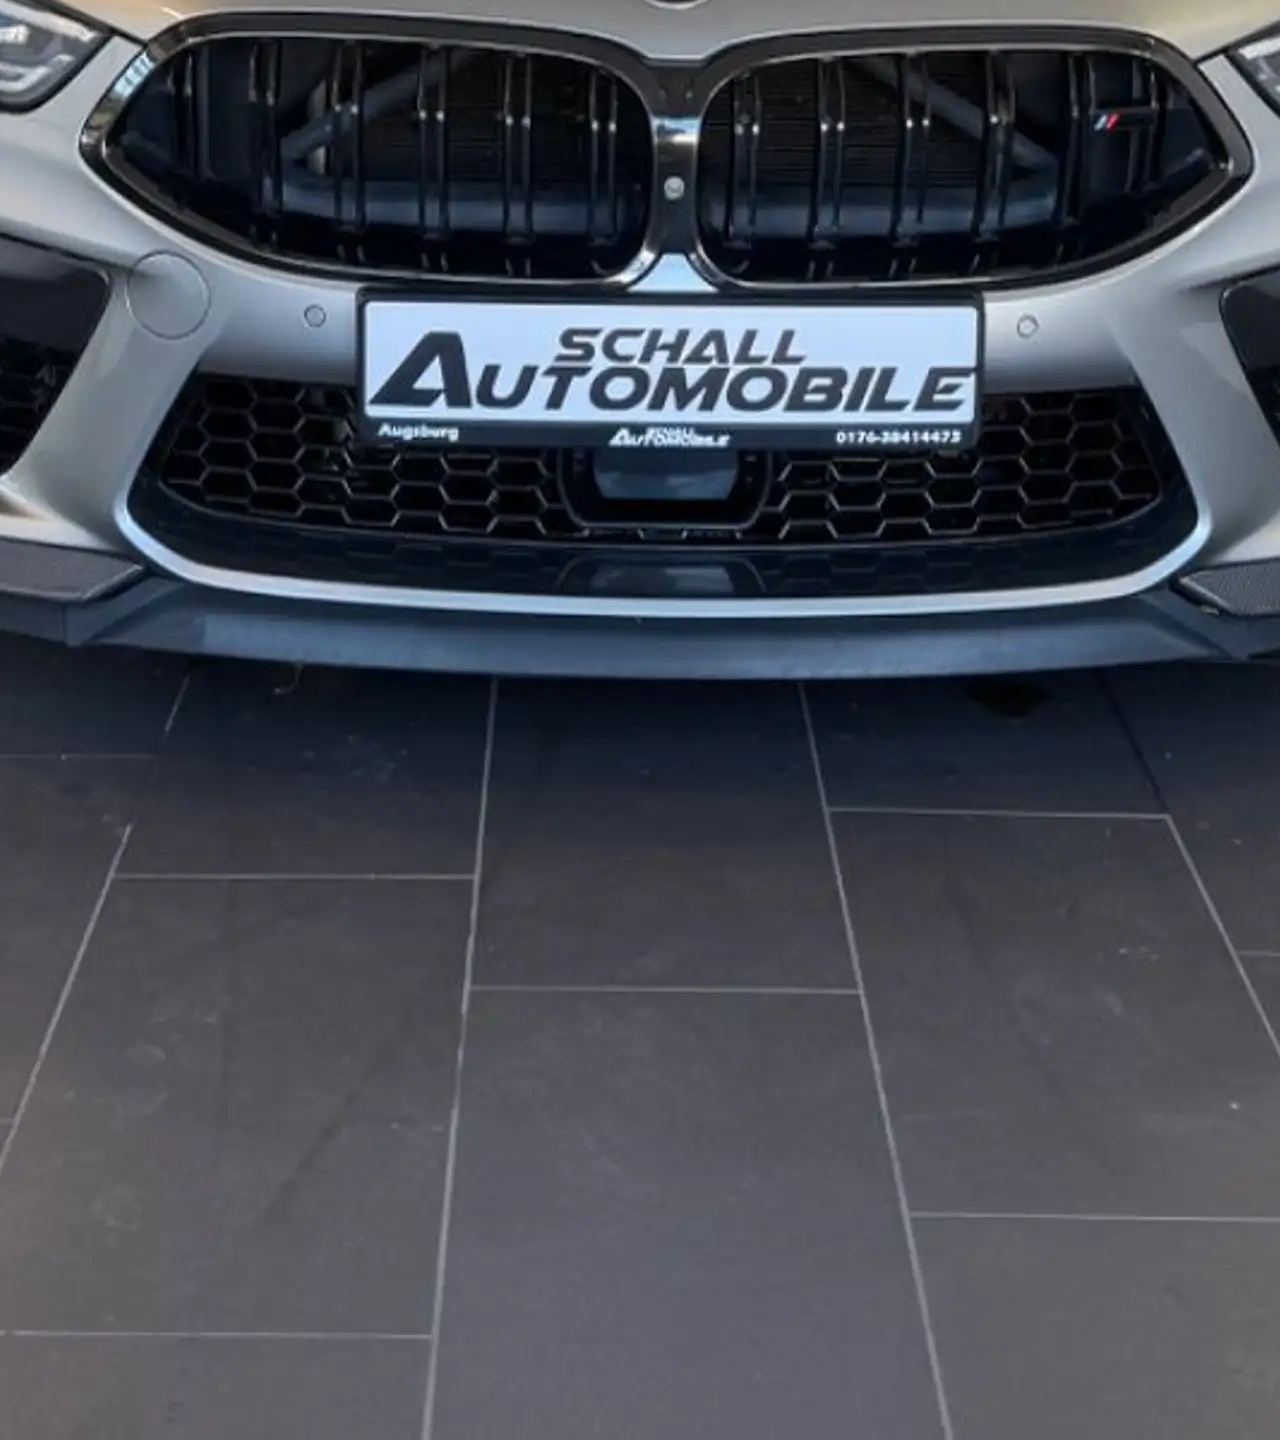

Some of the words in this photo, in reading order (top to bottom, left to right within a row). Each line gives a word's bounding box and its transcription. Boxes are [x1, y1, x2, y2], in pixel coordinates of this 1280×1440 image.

[553, 327, 806, 366] SCHALL
[368, 330, 976, 413] AUTOMOBILE
[378, 422, 459, 442] Augsburg
